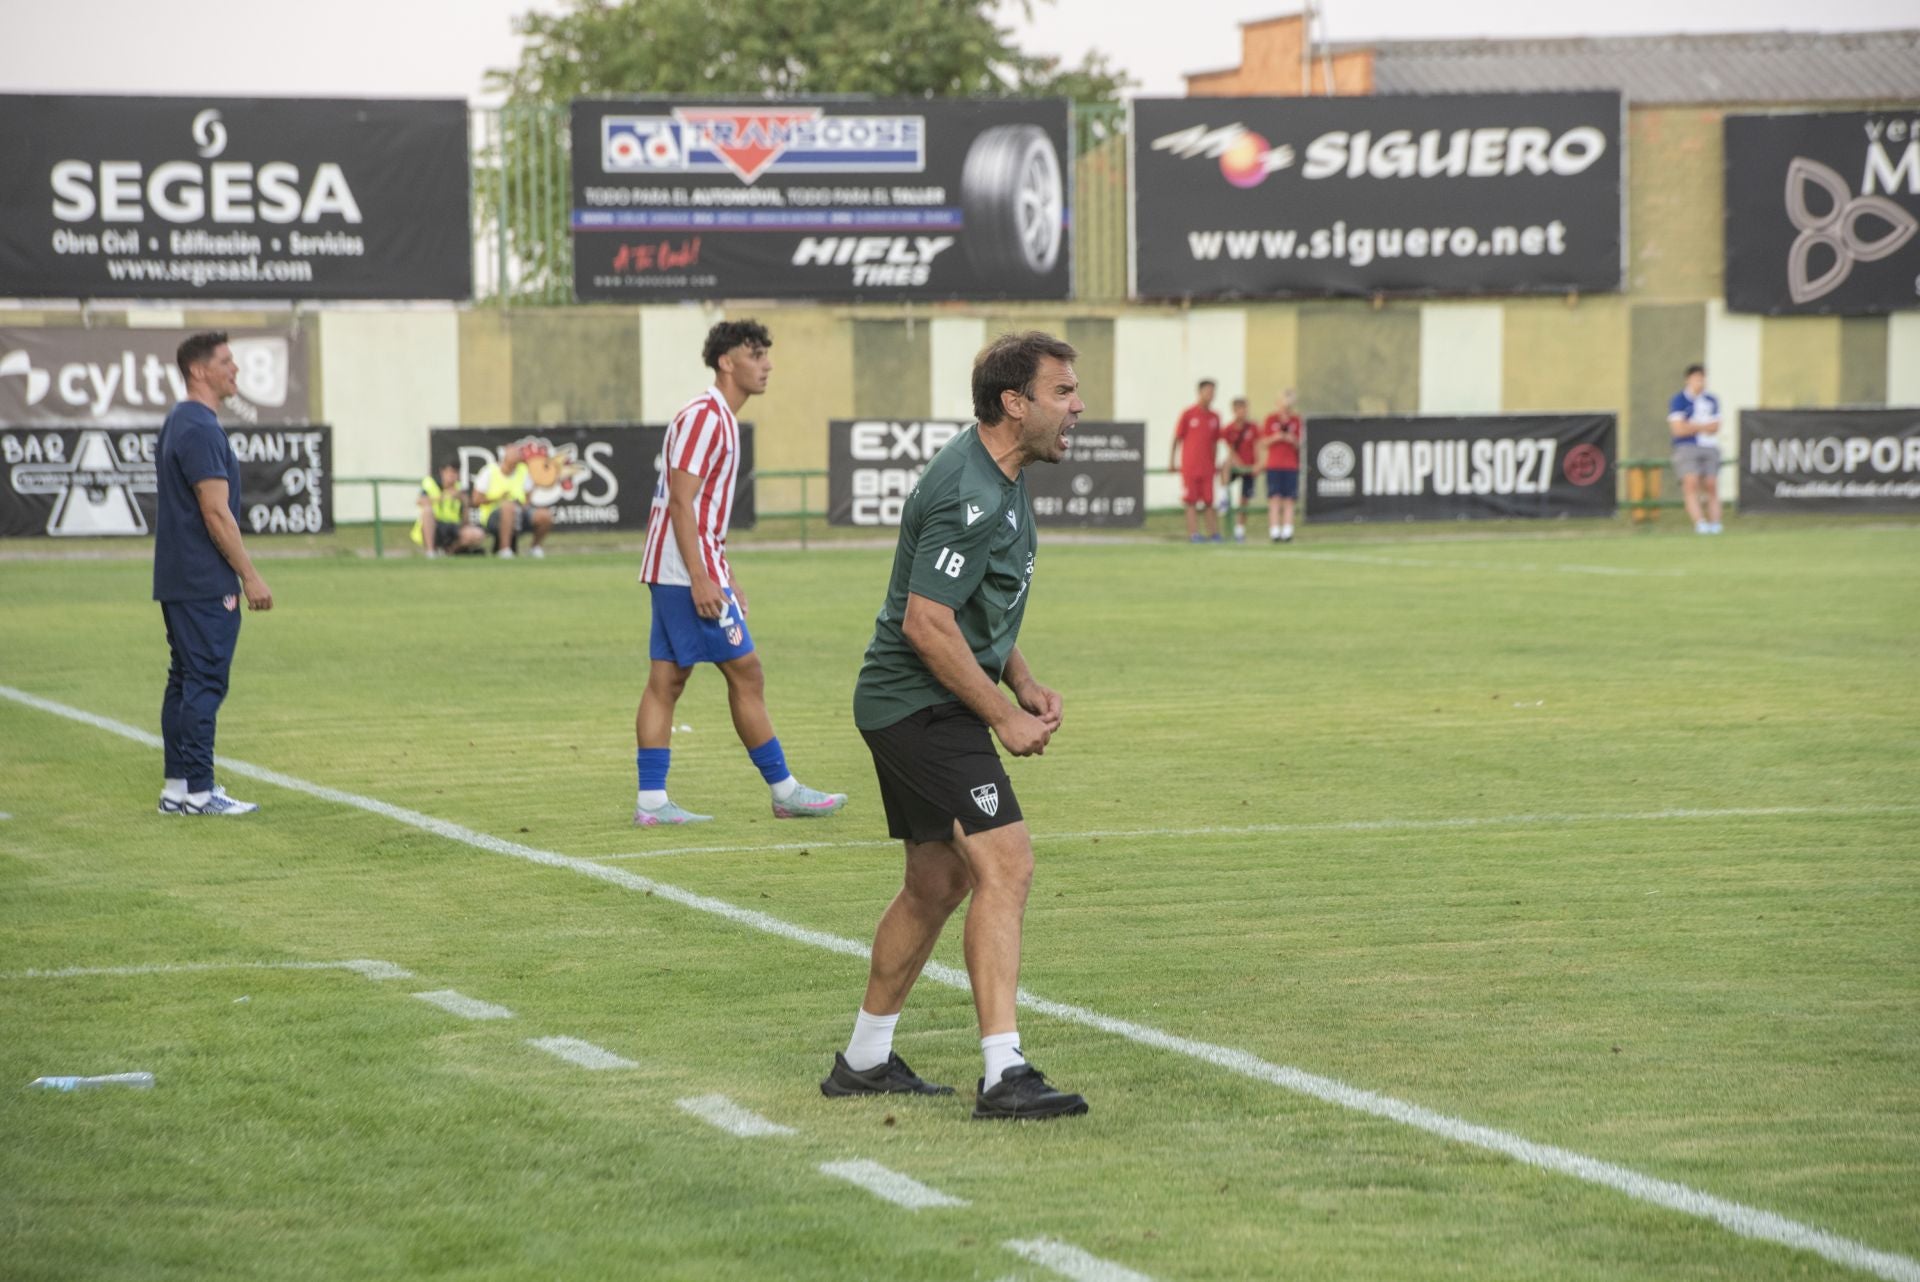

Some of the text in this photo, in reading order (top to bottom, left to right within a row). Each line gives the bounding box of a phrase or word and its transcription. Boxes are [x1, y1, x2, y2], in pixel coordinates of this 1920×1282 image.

[1301, 126, 1606, 180] SIGUERO
[50, 159, 363, 224] SEGESA
[583, 186, 631, 207] TODO
[632, 186, 671, 207] PARA
[672, 186, 690, 207] EL
[786, 186, 832, 207] TODO
[833, 186, 871, 207] PARA
[872, 186, 891, 207] EL
[891, 186, 947, 207] TALLER
[51, 228, 99, 255] Obra
[101, 228, 140, 256] Civil
[288, 229, 365, 256] Servicios
[791, 235, 955, 266] HIFLY
[1187, 219, 1568, 267] www.siguero.net
[107, 254, 314, 287] www.segesasl.com
[852, 263, 932, 287] TIRES
[1, 432, 67, 464] BAR
[851, 421, 976, 461] EXP
[281, 466, 323, 497] DE
[1361, 437, 1558, 496] IMPULSO27
[248, 503, 323, 534] PASO
